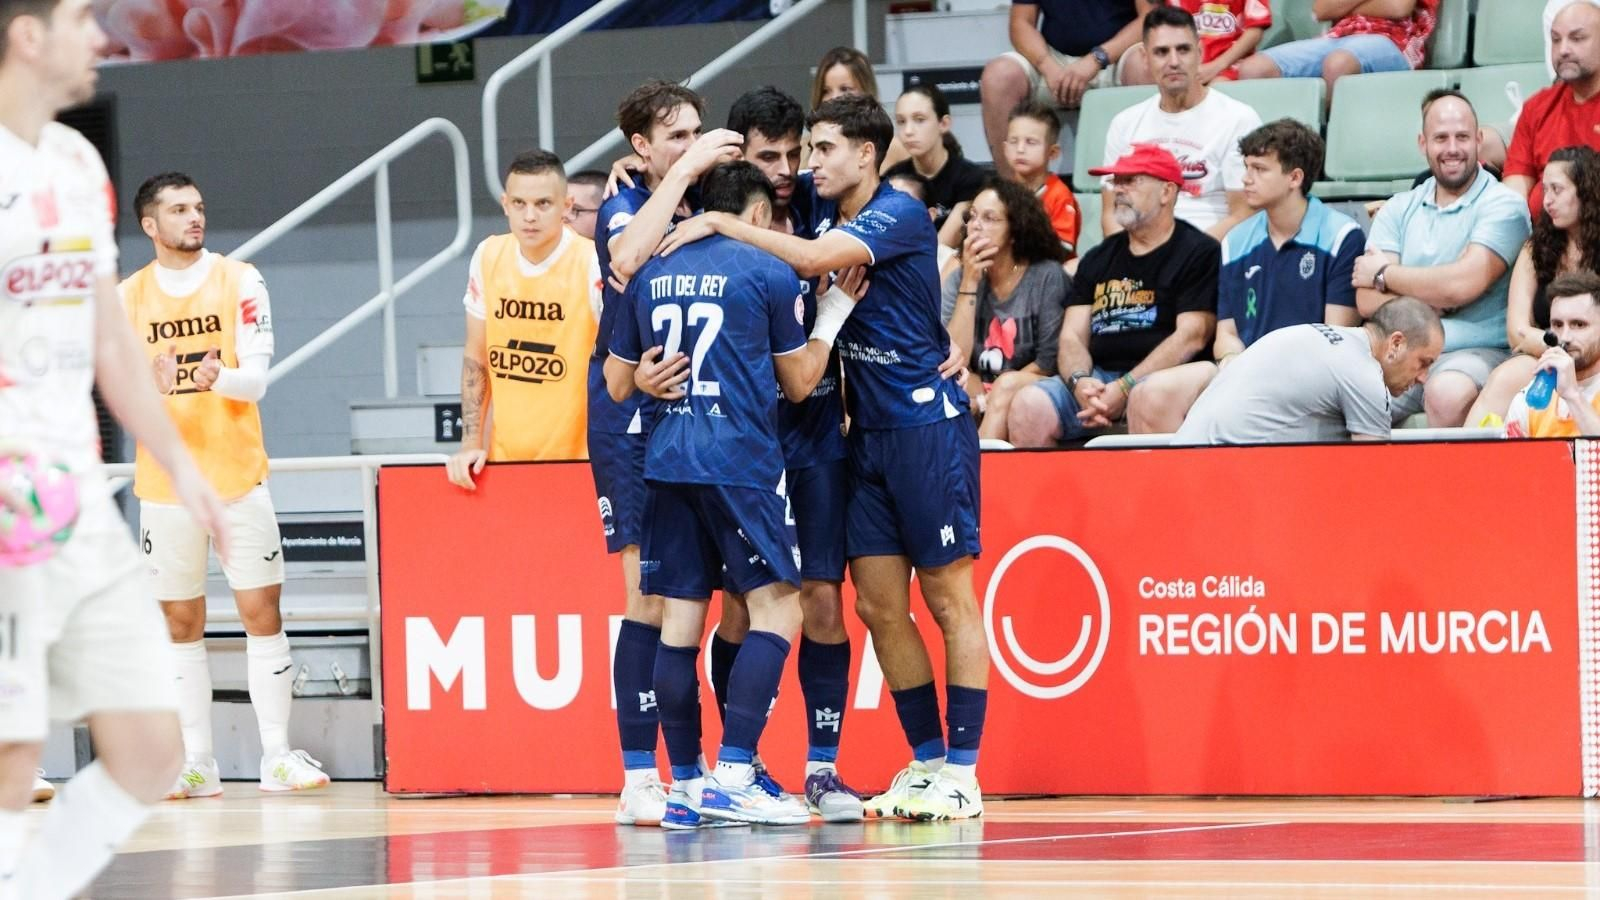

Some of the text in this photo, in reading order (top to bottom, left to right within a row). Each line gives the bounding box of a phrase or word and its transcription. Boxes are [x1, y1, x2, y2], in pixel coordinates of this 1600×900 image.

[649, 275, 728, 300] TITI DEL REY
[651, 302, 724, 396] 22
[282, 536, 362, 548] Ayuntamiento de Murcia
[1138, 575, 1265, 599] Costa Cálida
[1139, 605, 1552, 655] REGIÓN DE MURCIA
